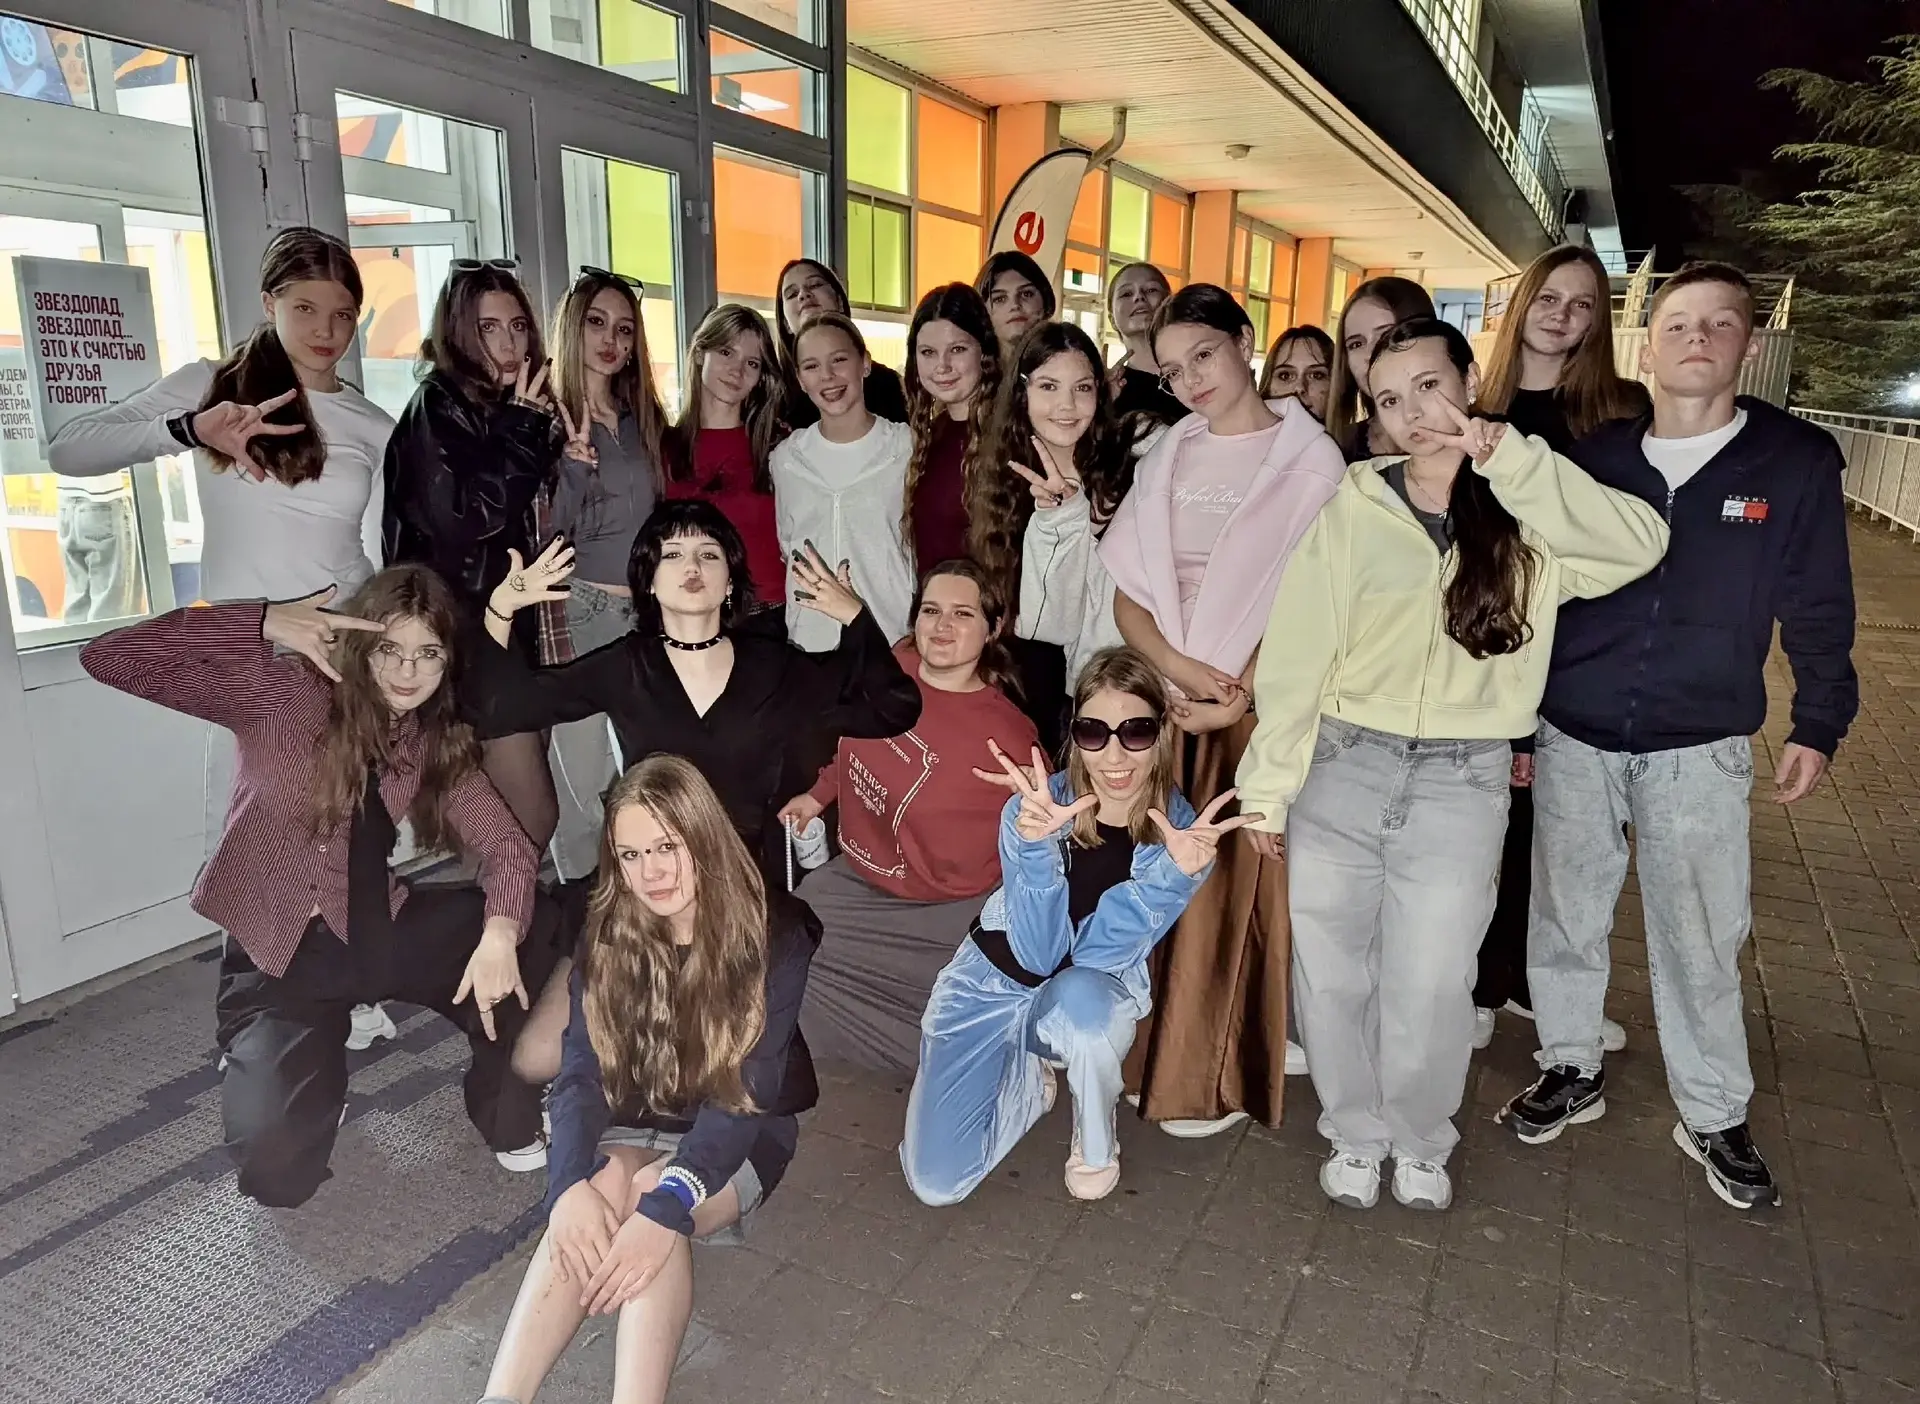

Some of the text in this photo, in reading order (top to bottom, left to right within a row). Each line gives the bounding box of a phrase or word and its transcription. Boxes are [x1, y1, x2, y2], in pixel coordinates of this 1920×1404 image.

[33, 291, 125, 318] ЗВЕЗДОПАД,
[36, 315, 133, 340] ЗВЕЗДОПАД...
[40, 338, 146, 361] ЭТО К СЧАСТЬЮ
[45, 362, 102, 383] ДРУЗЬЯ
[47, 385, 119, 404] ГОВОРЯТ...
[3, 427, 36, 440] МЕЧТО
[1728, 494, 1767, 503] TOMMY
[1721, 516, 1762, 525] JEANS
[849, 752, 888, 800] ЕВГЕНИЙ
